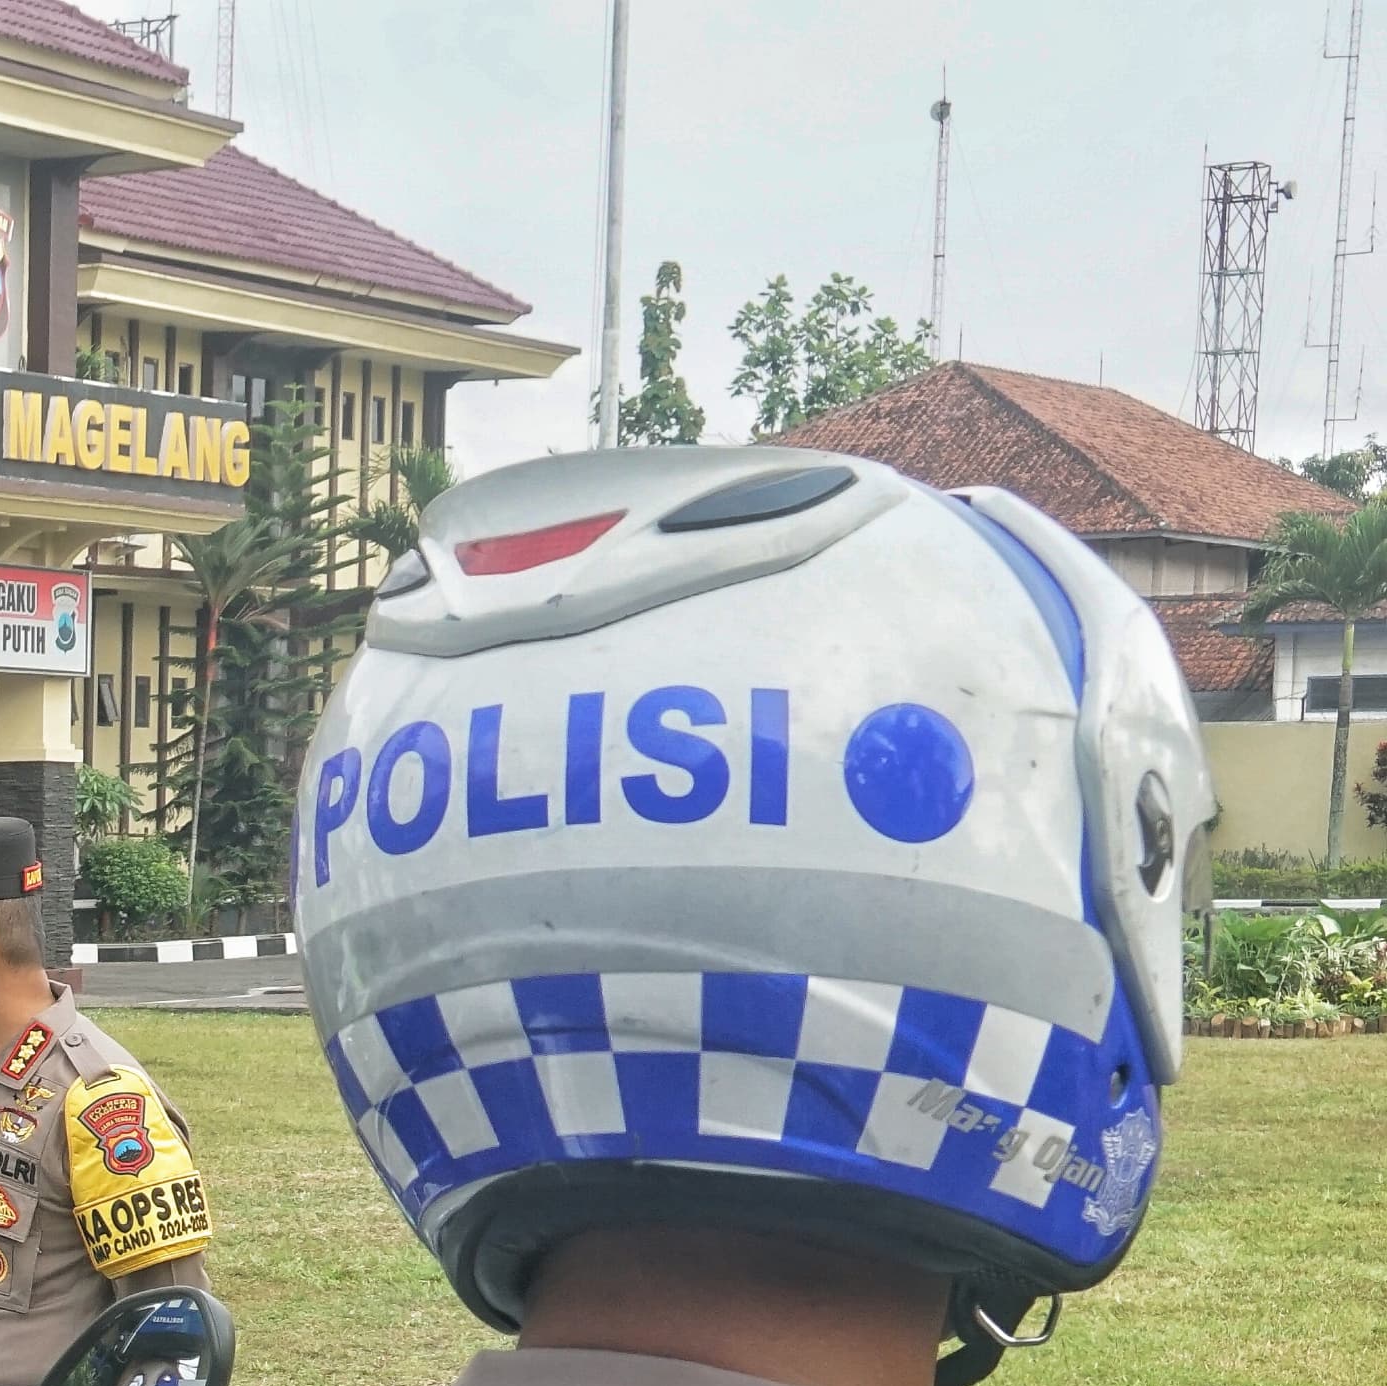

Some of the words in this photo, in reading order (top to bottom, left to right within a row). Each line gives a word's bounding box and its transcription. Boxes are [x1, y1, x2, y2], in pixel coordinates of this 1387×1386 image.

[2, 389, 250, 486] MAGELANG
[2, 625, 46, 654] PUTIH
[314, 685, 790, 888] POLISI
[77, 1207, 113, 1247] KA
[111, 1187, 171, 1233] OPS
[172, 1178, 205, 1216] RES
[114, 1227, 156, 1256] CANDI
